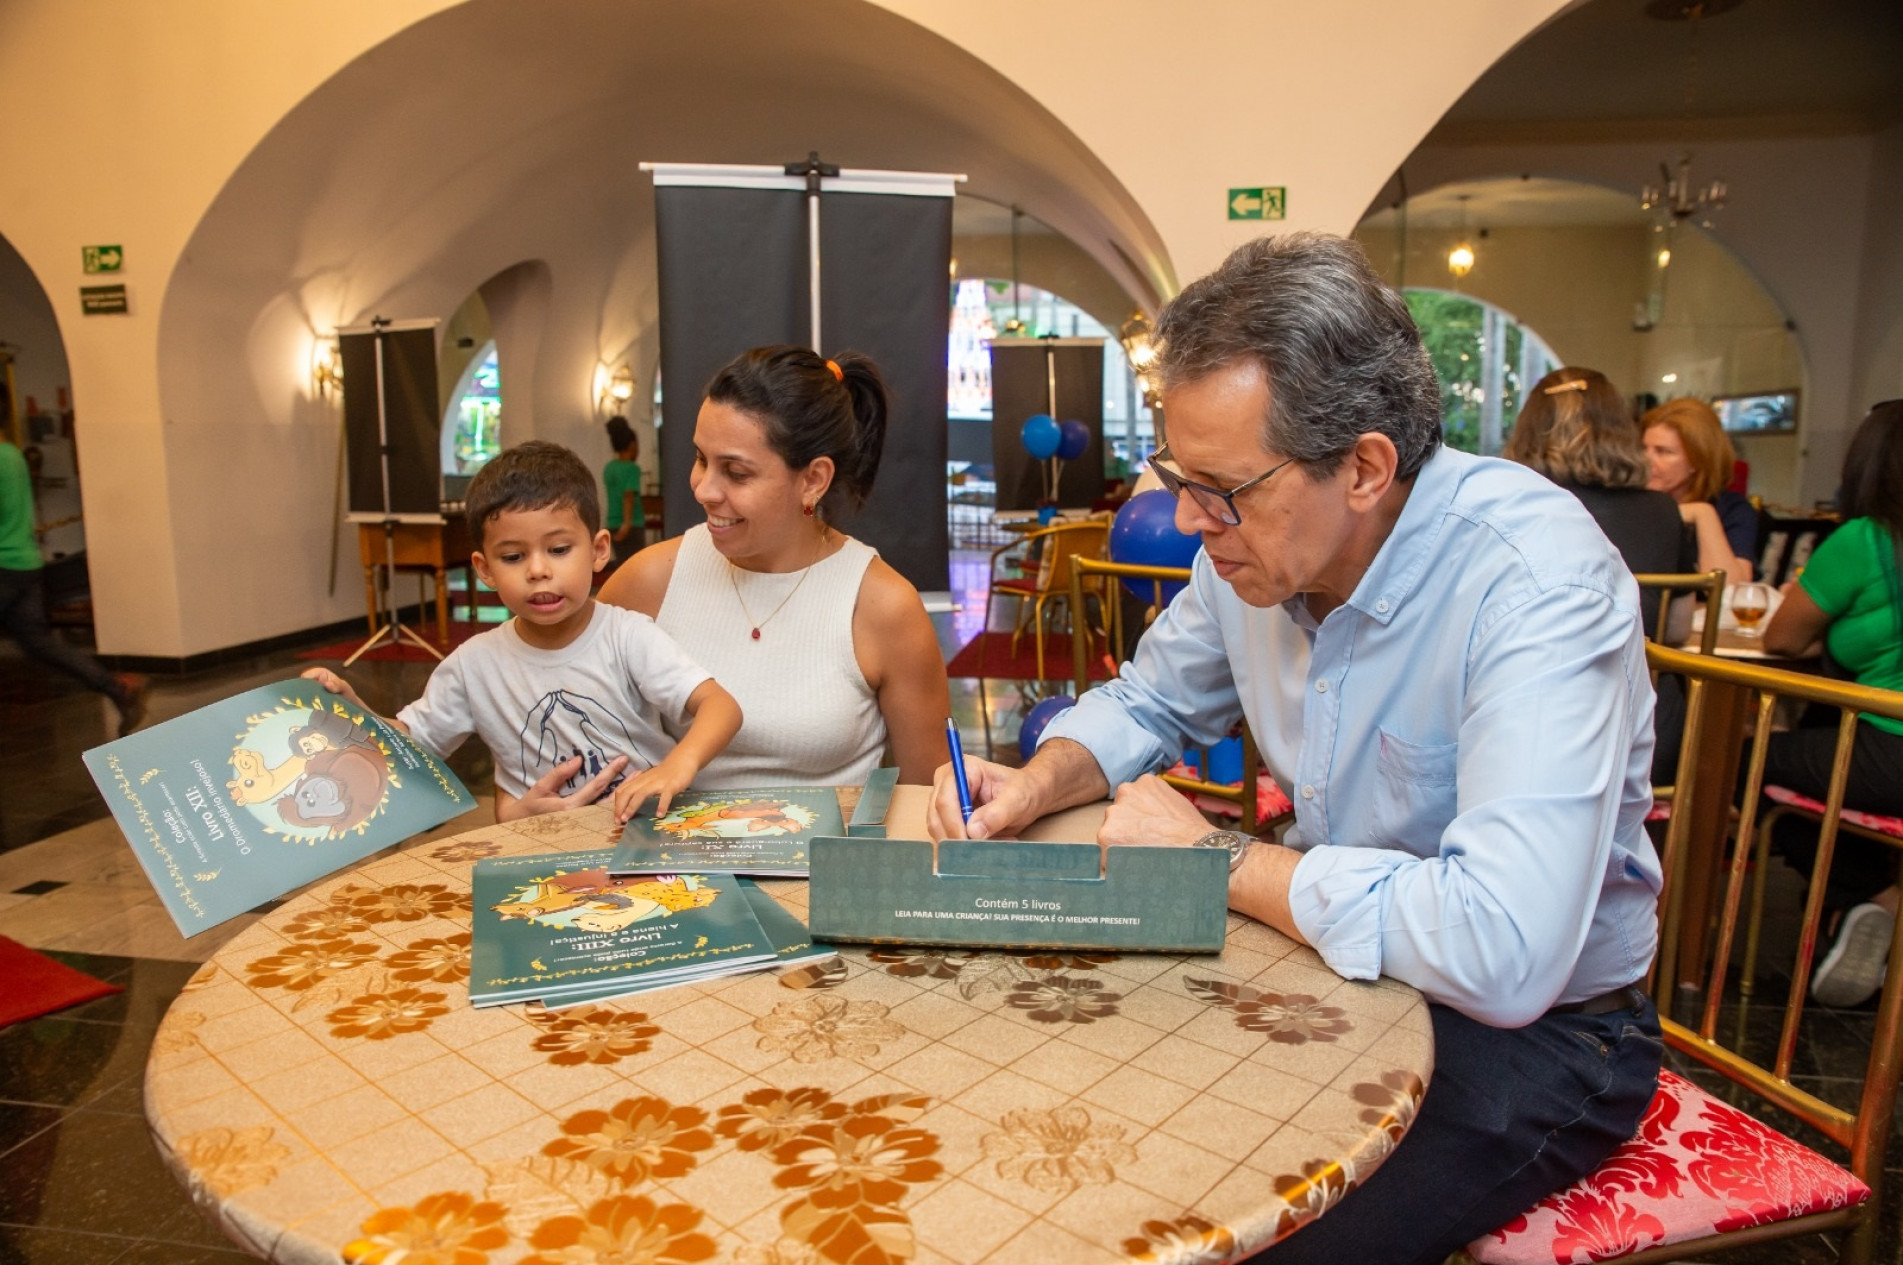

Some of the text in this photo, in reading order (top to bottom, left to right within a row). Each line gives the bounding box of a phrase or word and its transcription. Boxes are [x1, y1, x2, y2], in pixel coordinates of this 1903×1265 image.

[185, 785, 224, 842] Livro XII:
[189, 759, 251, 855] O Dromedário invejoso!
[162, 809, 186, 844] Coleção:
[975, 897, 1062, 911] Contém 5 livros
[894, 910, 912, 919] LEIA
[912, 910, 933, 919] PARA
[934, 911, 954, 919] UMA
[993, 913, 1009, 921] SUA
[1010, 914, 1050, 923] PRESENÇA
[1051, 914, 1056, 923] É
[1065, 916, 1099, 924] MELHOR
[1099, 917, 1141, 926] PRESENTE!
[633, 925, 667, 933] hiena
[550, 933, 607, 946] injustiça!
[571, 932, 662, 951] Livro XIII:
[594, 950, 647, 962] Coleção:
